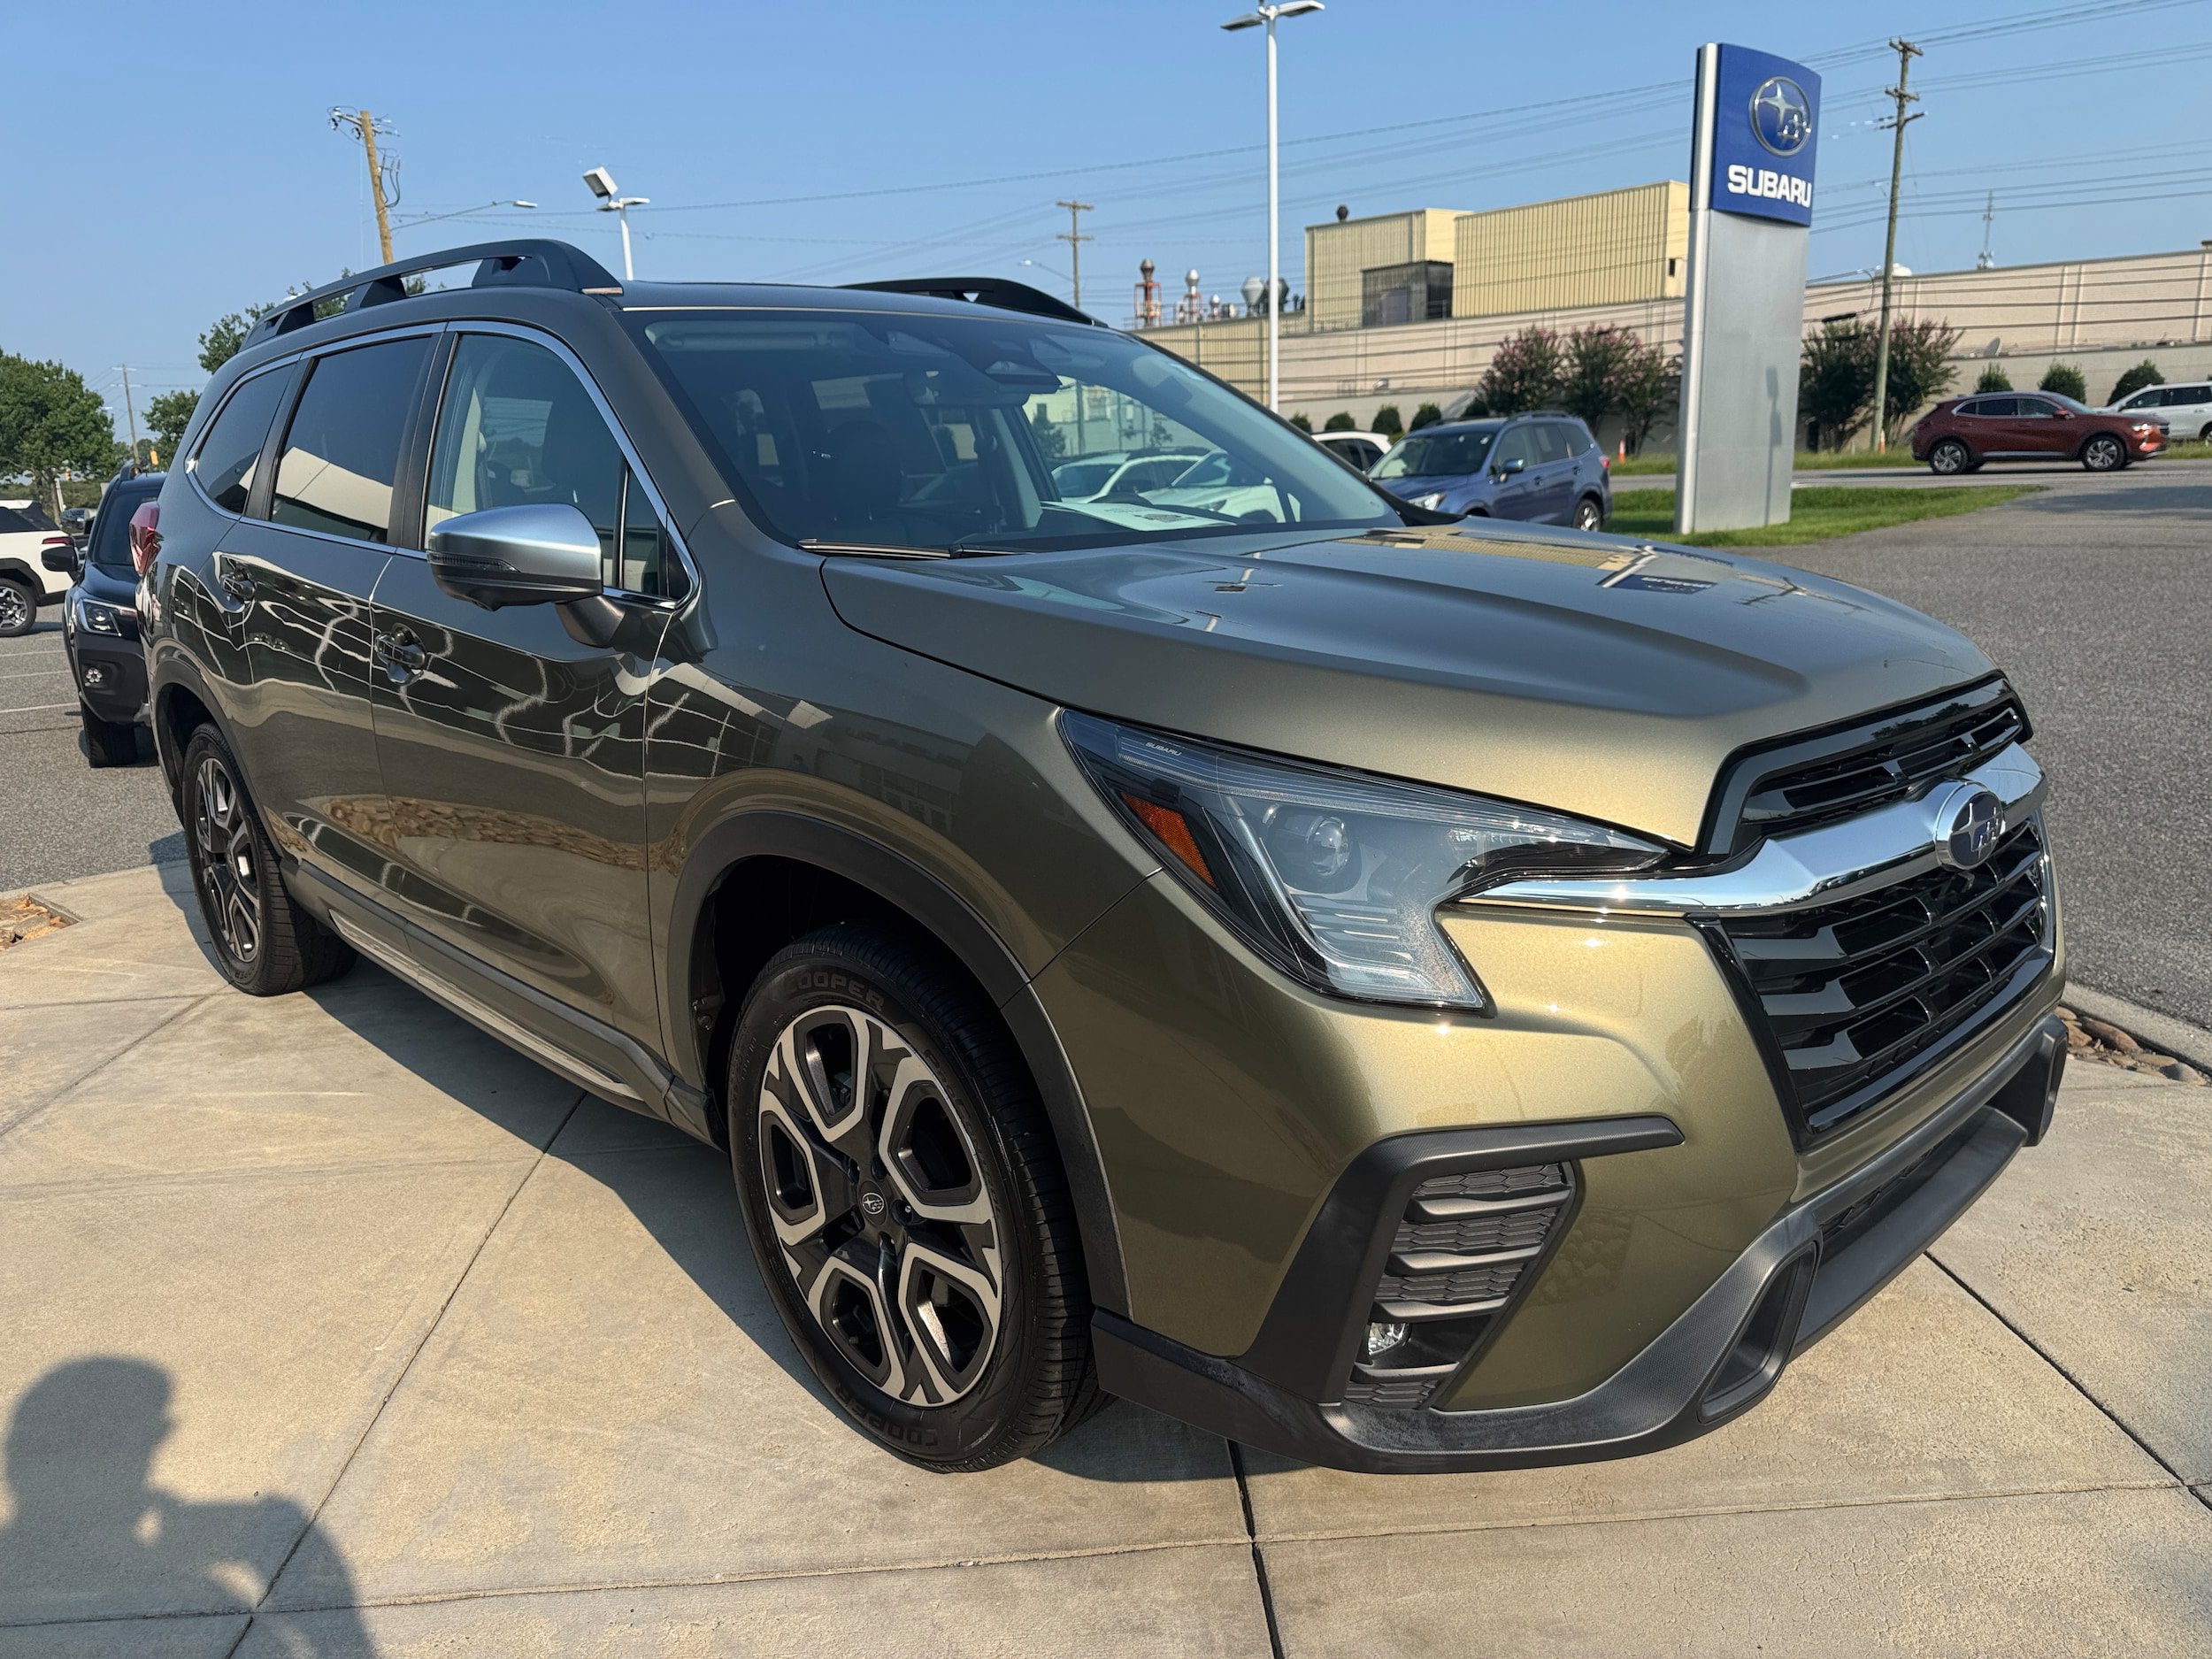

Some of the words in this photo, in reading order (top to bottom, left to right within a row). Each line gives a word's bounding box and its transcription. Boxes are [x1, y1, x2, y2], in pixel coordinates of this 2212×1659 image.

[1728, 165, 1811, 208] SUBARU
[1145, 741, 1182, 757] SUBARU
[783, 972, 885, 1011] OOPER
[835, 1386, 939, 1447] COOPER
